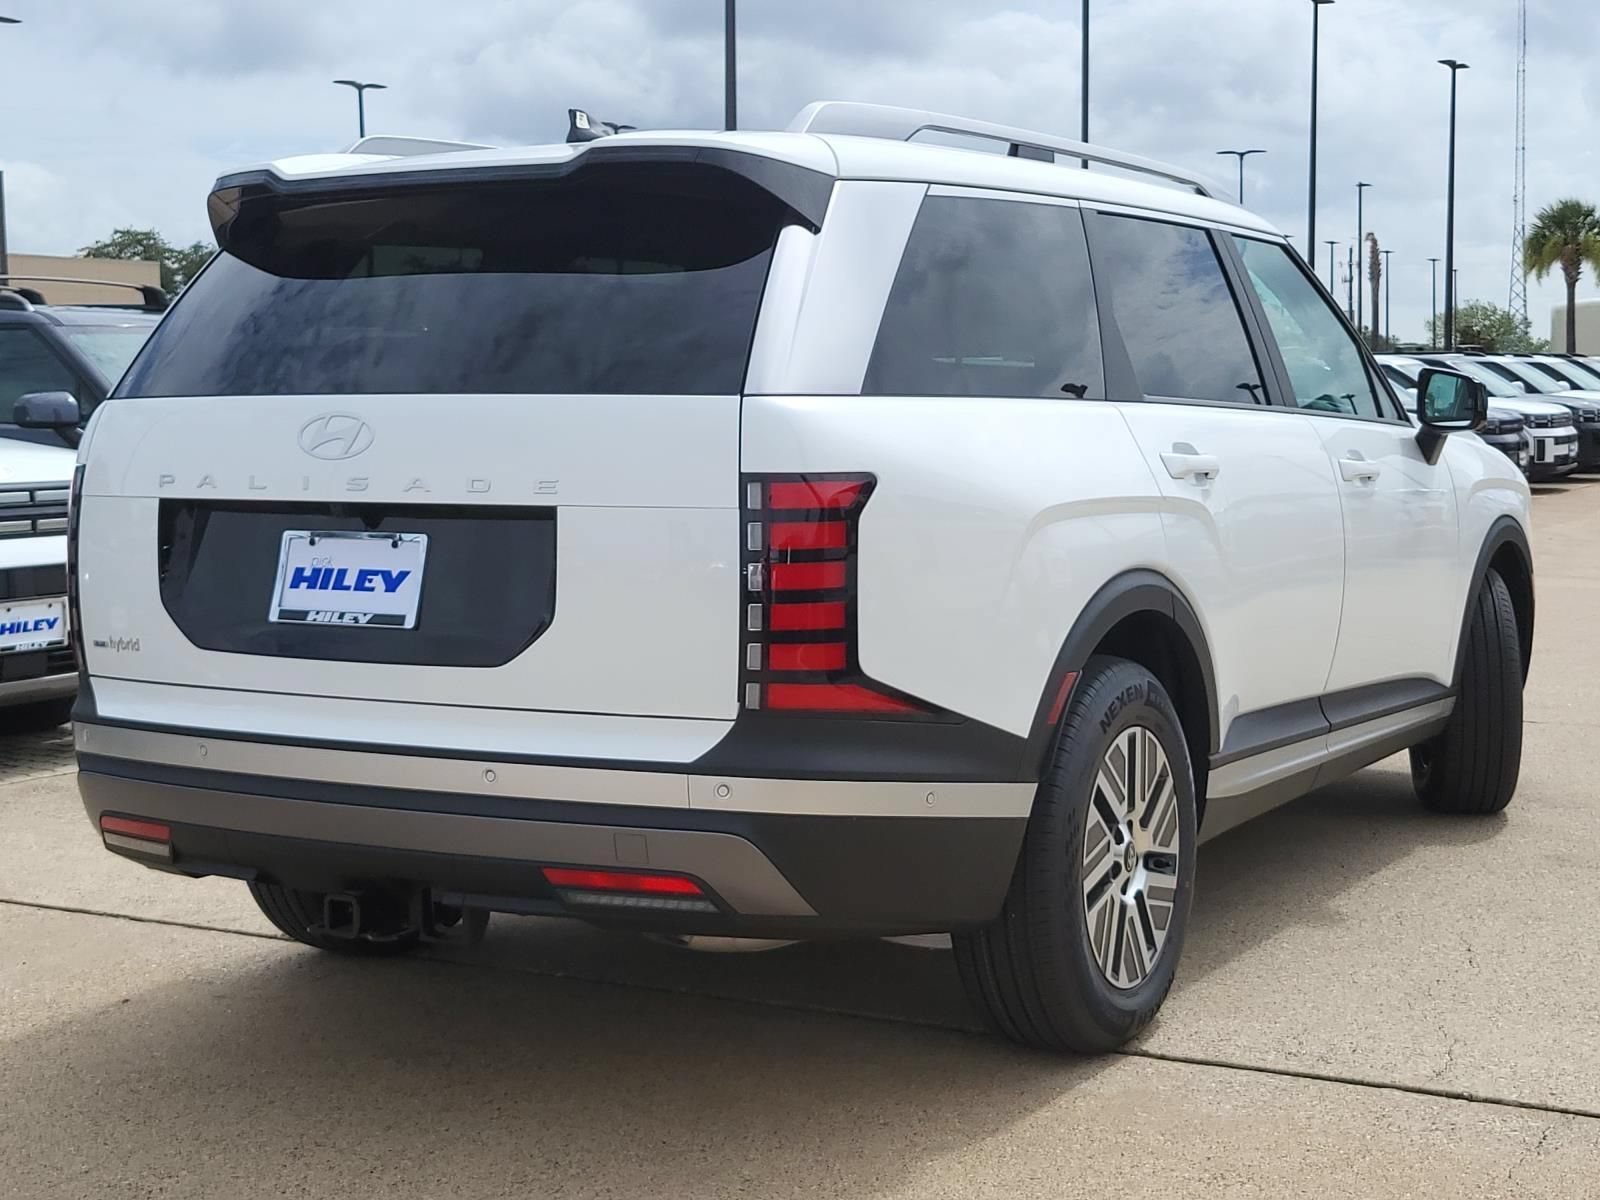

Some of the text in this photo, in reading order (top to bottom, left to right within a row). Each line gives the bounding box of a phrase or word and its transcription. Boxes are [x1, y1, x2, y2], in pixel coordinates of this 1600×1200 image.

[158, 473, 560, 495] PALISADE
[289, 566, 411, 593] HILEY
[0, 616, 59, 635] HILEY
[306, 610, 374, 624] HILEY
[109, 635, 140, 653] hybrid
[1098, 683, 1144, 735] NEXEN
